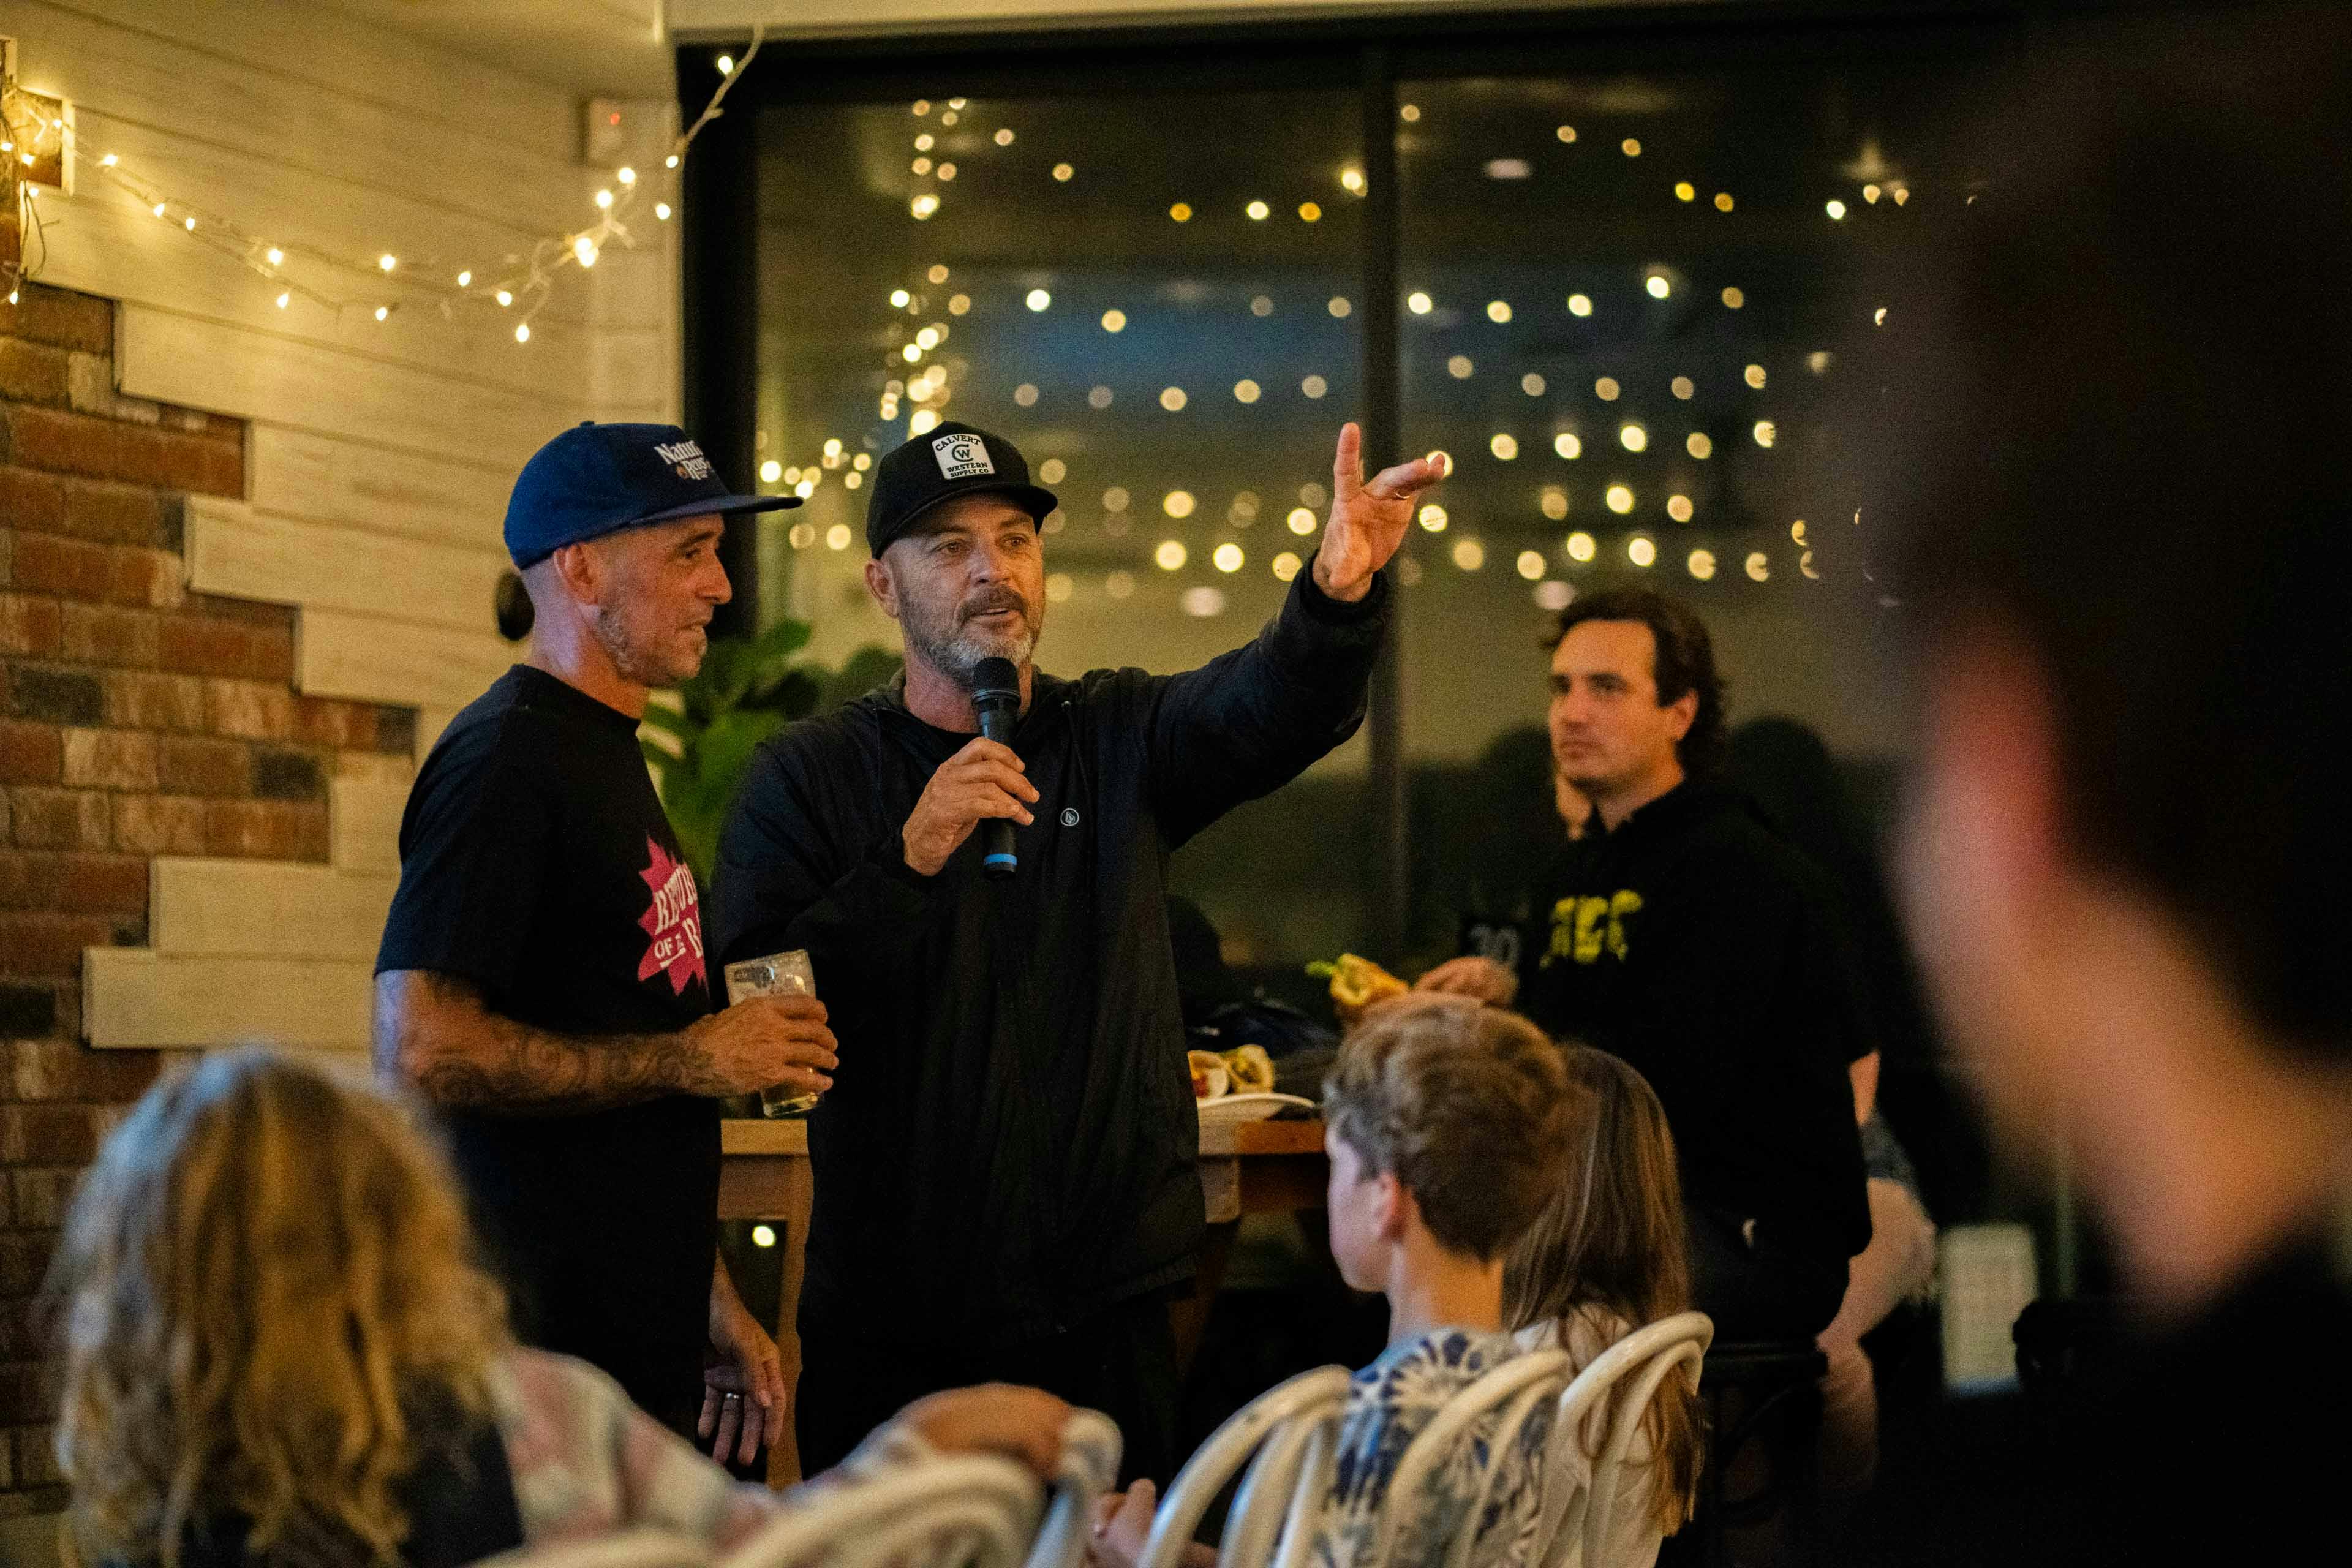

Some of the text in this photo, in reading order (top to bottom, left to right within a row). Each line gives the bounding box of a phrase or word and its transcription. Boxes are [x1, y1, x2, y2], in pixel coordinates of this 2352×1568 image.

[935, 435, 980, 451] CALVERT
[946, 462, 988, 472] WESTERN
[950, 469, 977, 477] SUPPLY
[654, 937, 673, 959] OF
